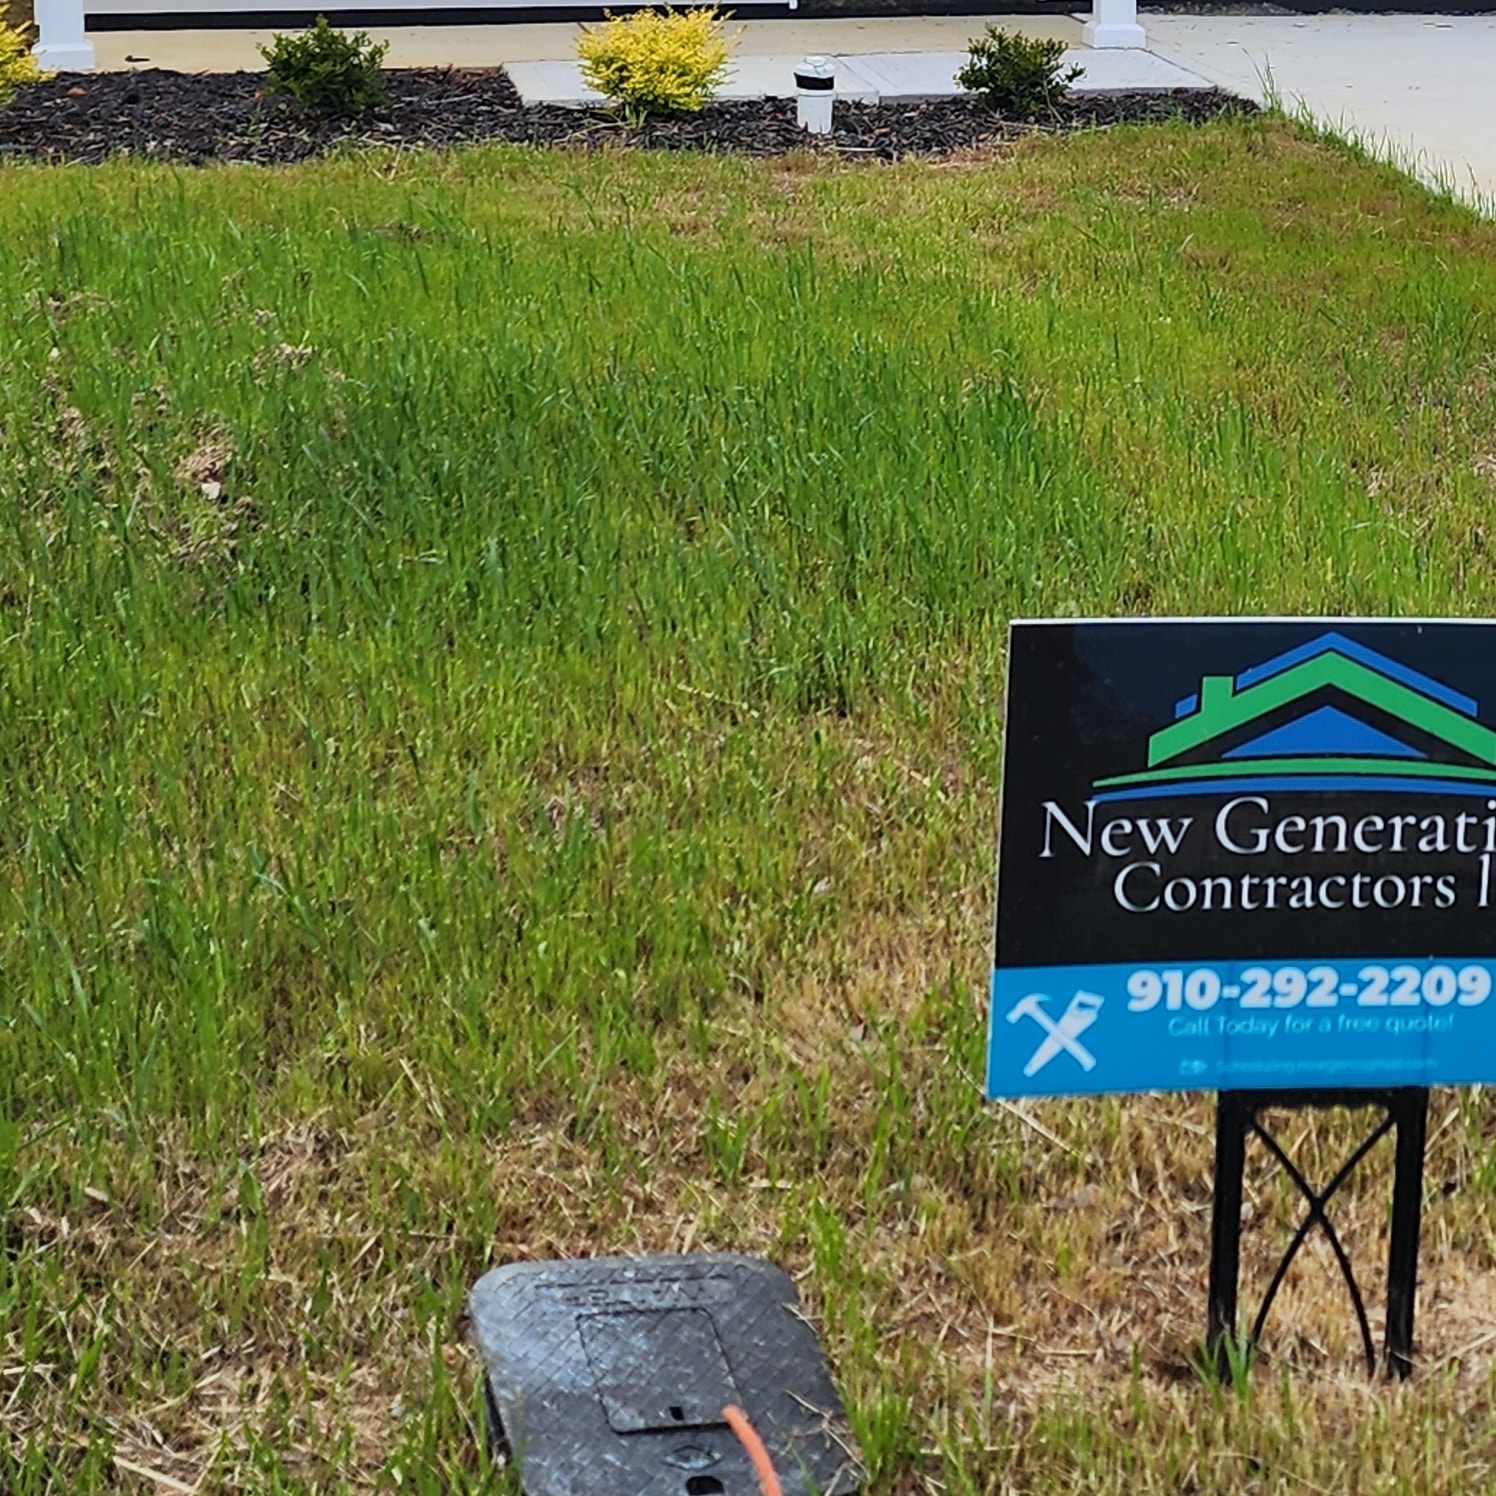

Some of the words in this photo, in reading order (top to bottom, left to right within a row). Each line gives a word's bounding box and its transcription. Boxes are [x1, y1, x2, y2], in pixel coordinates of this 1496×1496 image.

[1038, 799, 1194, 859] New
[1113, 861, 1457, 913] Contractors
[1126, 965, 1493, 1013] 910-292-2209
[1168, 1016, 1210, 1037] Call
[1216, 1015, 1279, 1039] Today
[1284, 1013, 1313, 1034] for
[1317, 1018, 1333, 1033] a
[1337, 1013, 1380, 1033] free
[1384, 1012, 1455, 1036] quote!
